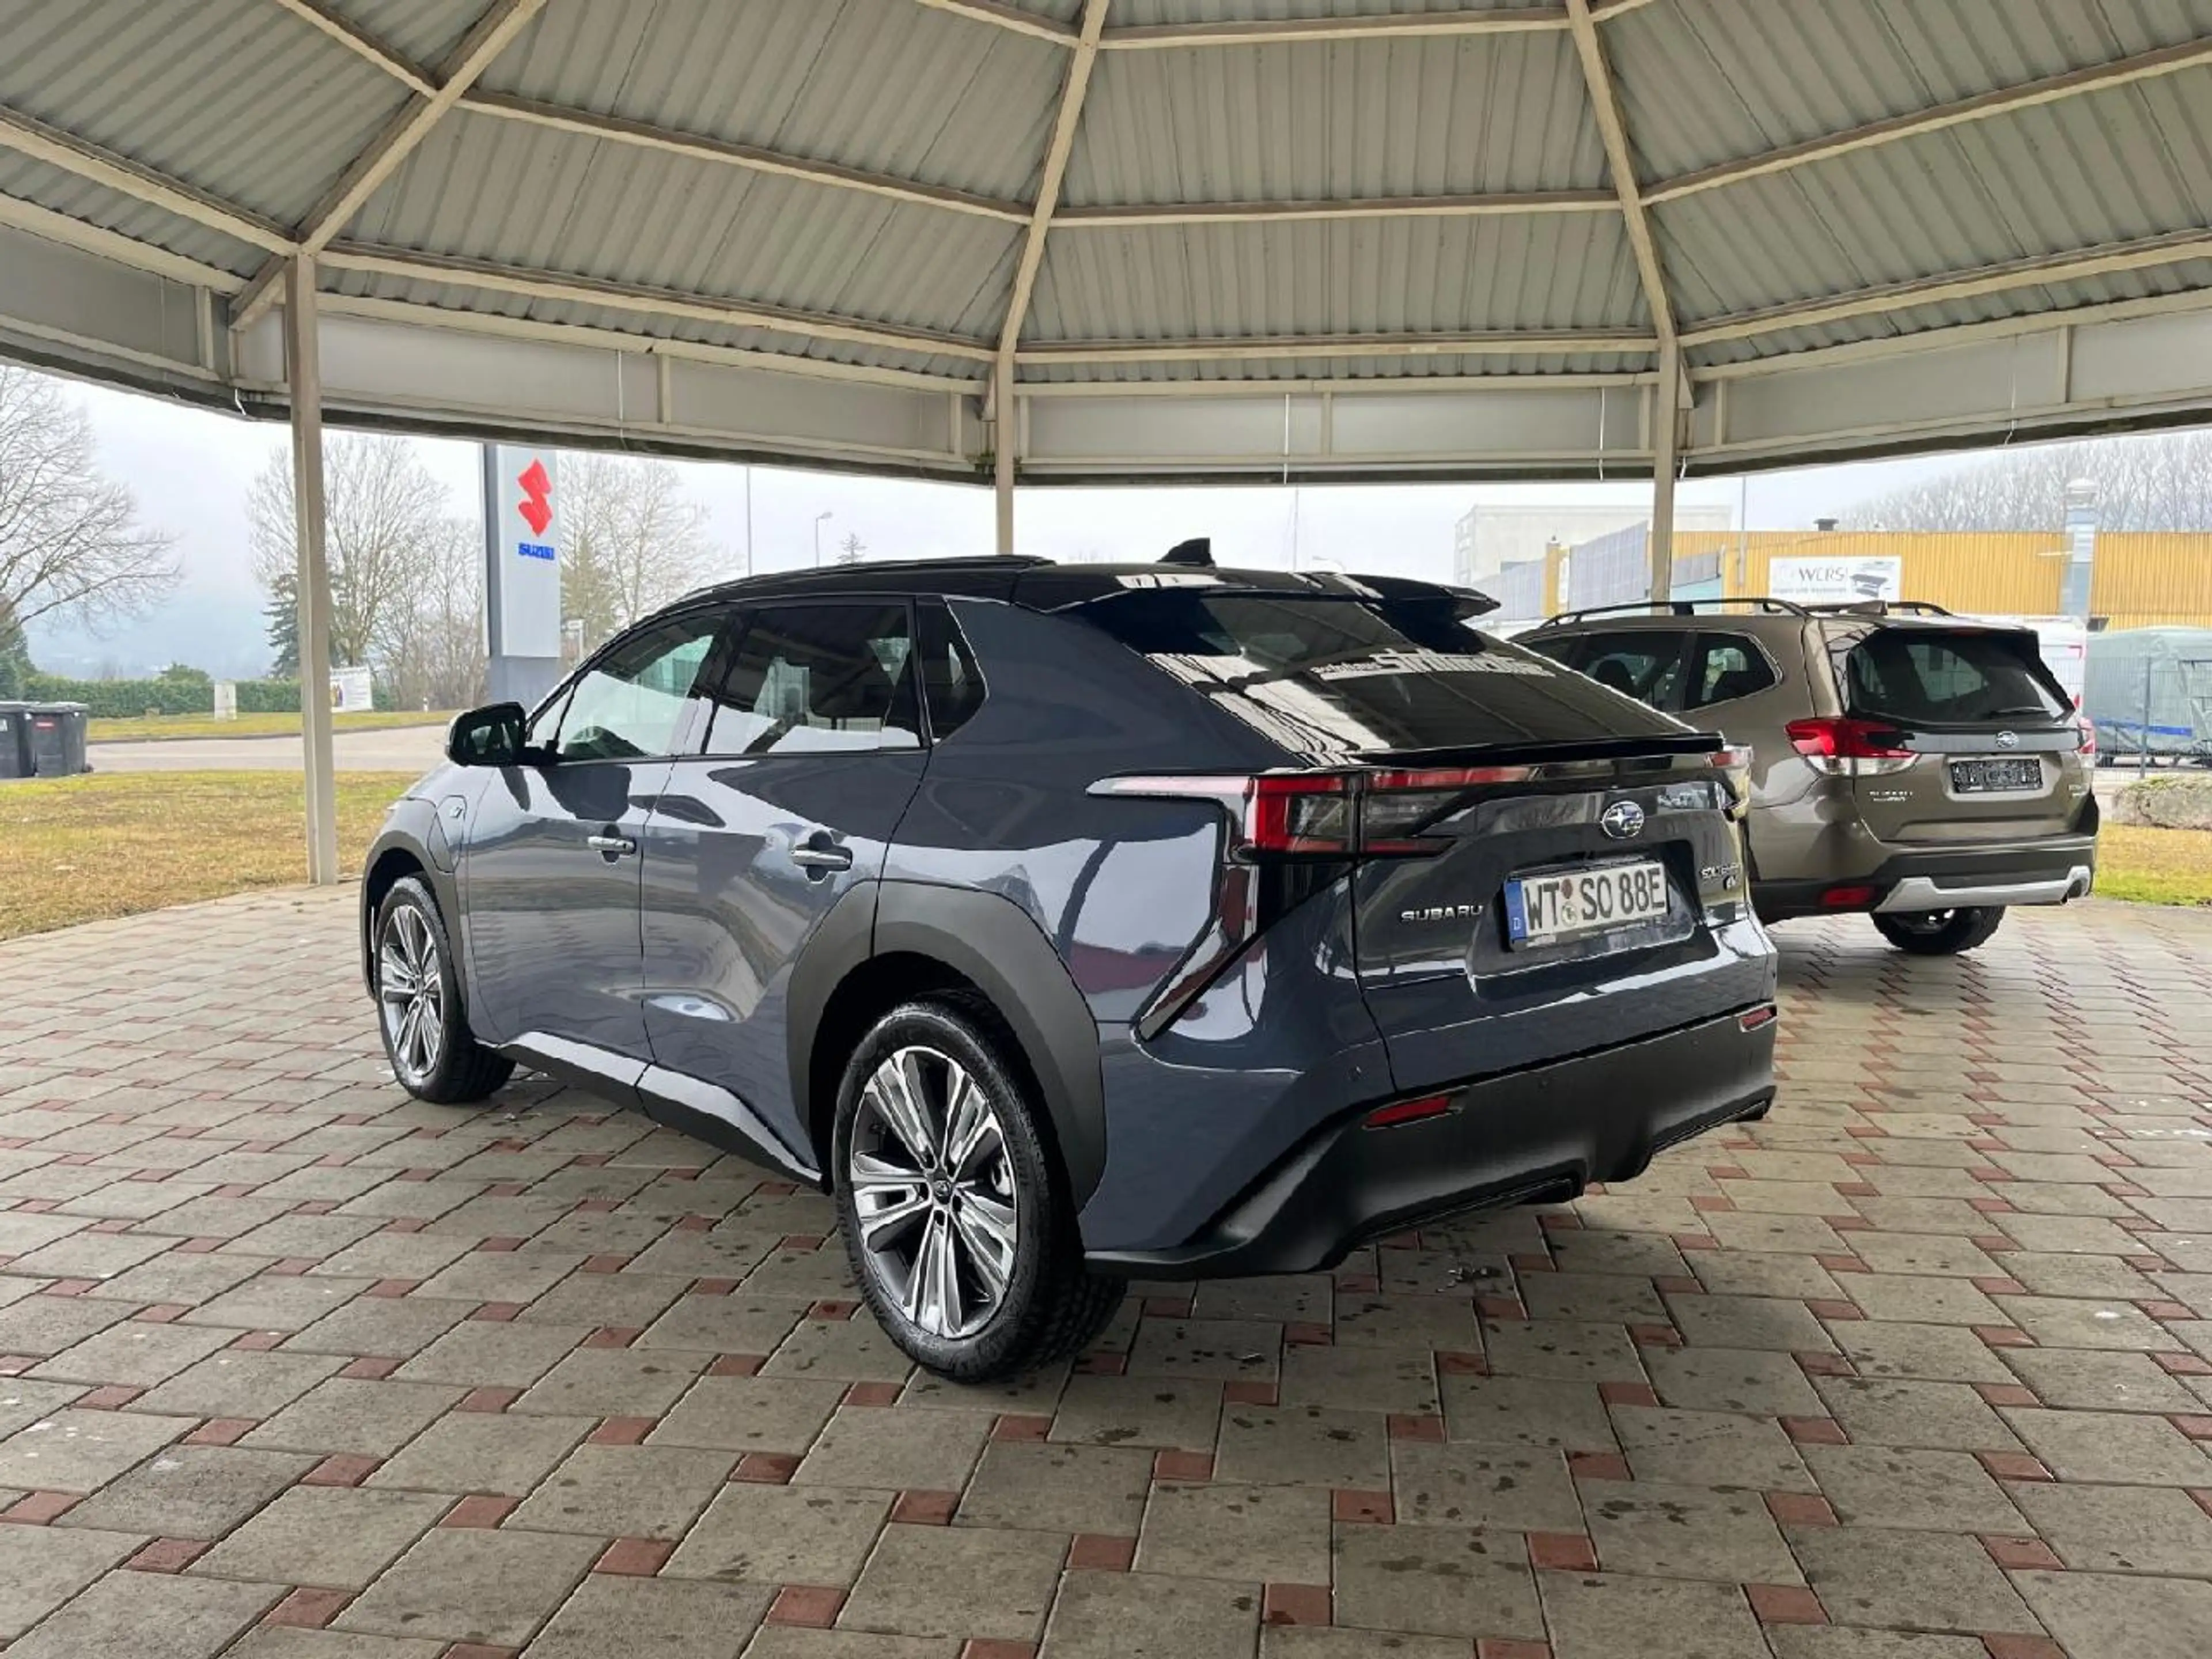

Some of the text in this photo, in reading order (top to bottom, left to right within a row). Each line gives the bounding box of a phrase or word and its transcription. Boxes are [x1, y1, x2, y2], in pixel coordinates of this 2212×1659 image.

[1401, 905, 1483, 922] SUBARU
[1525, 881, 1559, 930] WT
[1619, 868, 1665, 915] 88E
